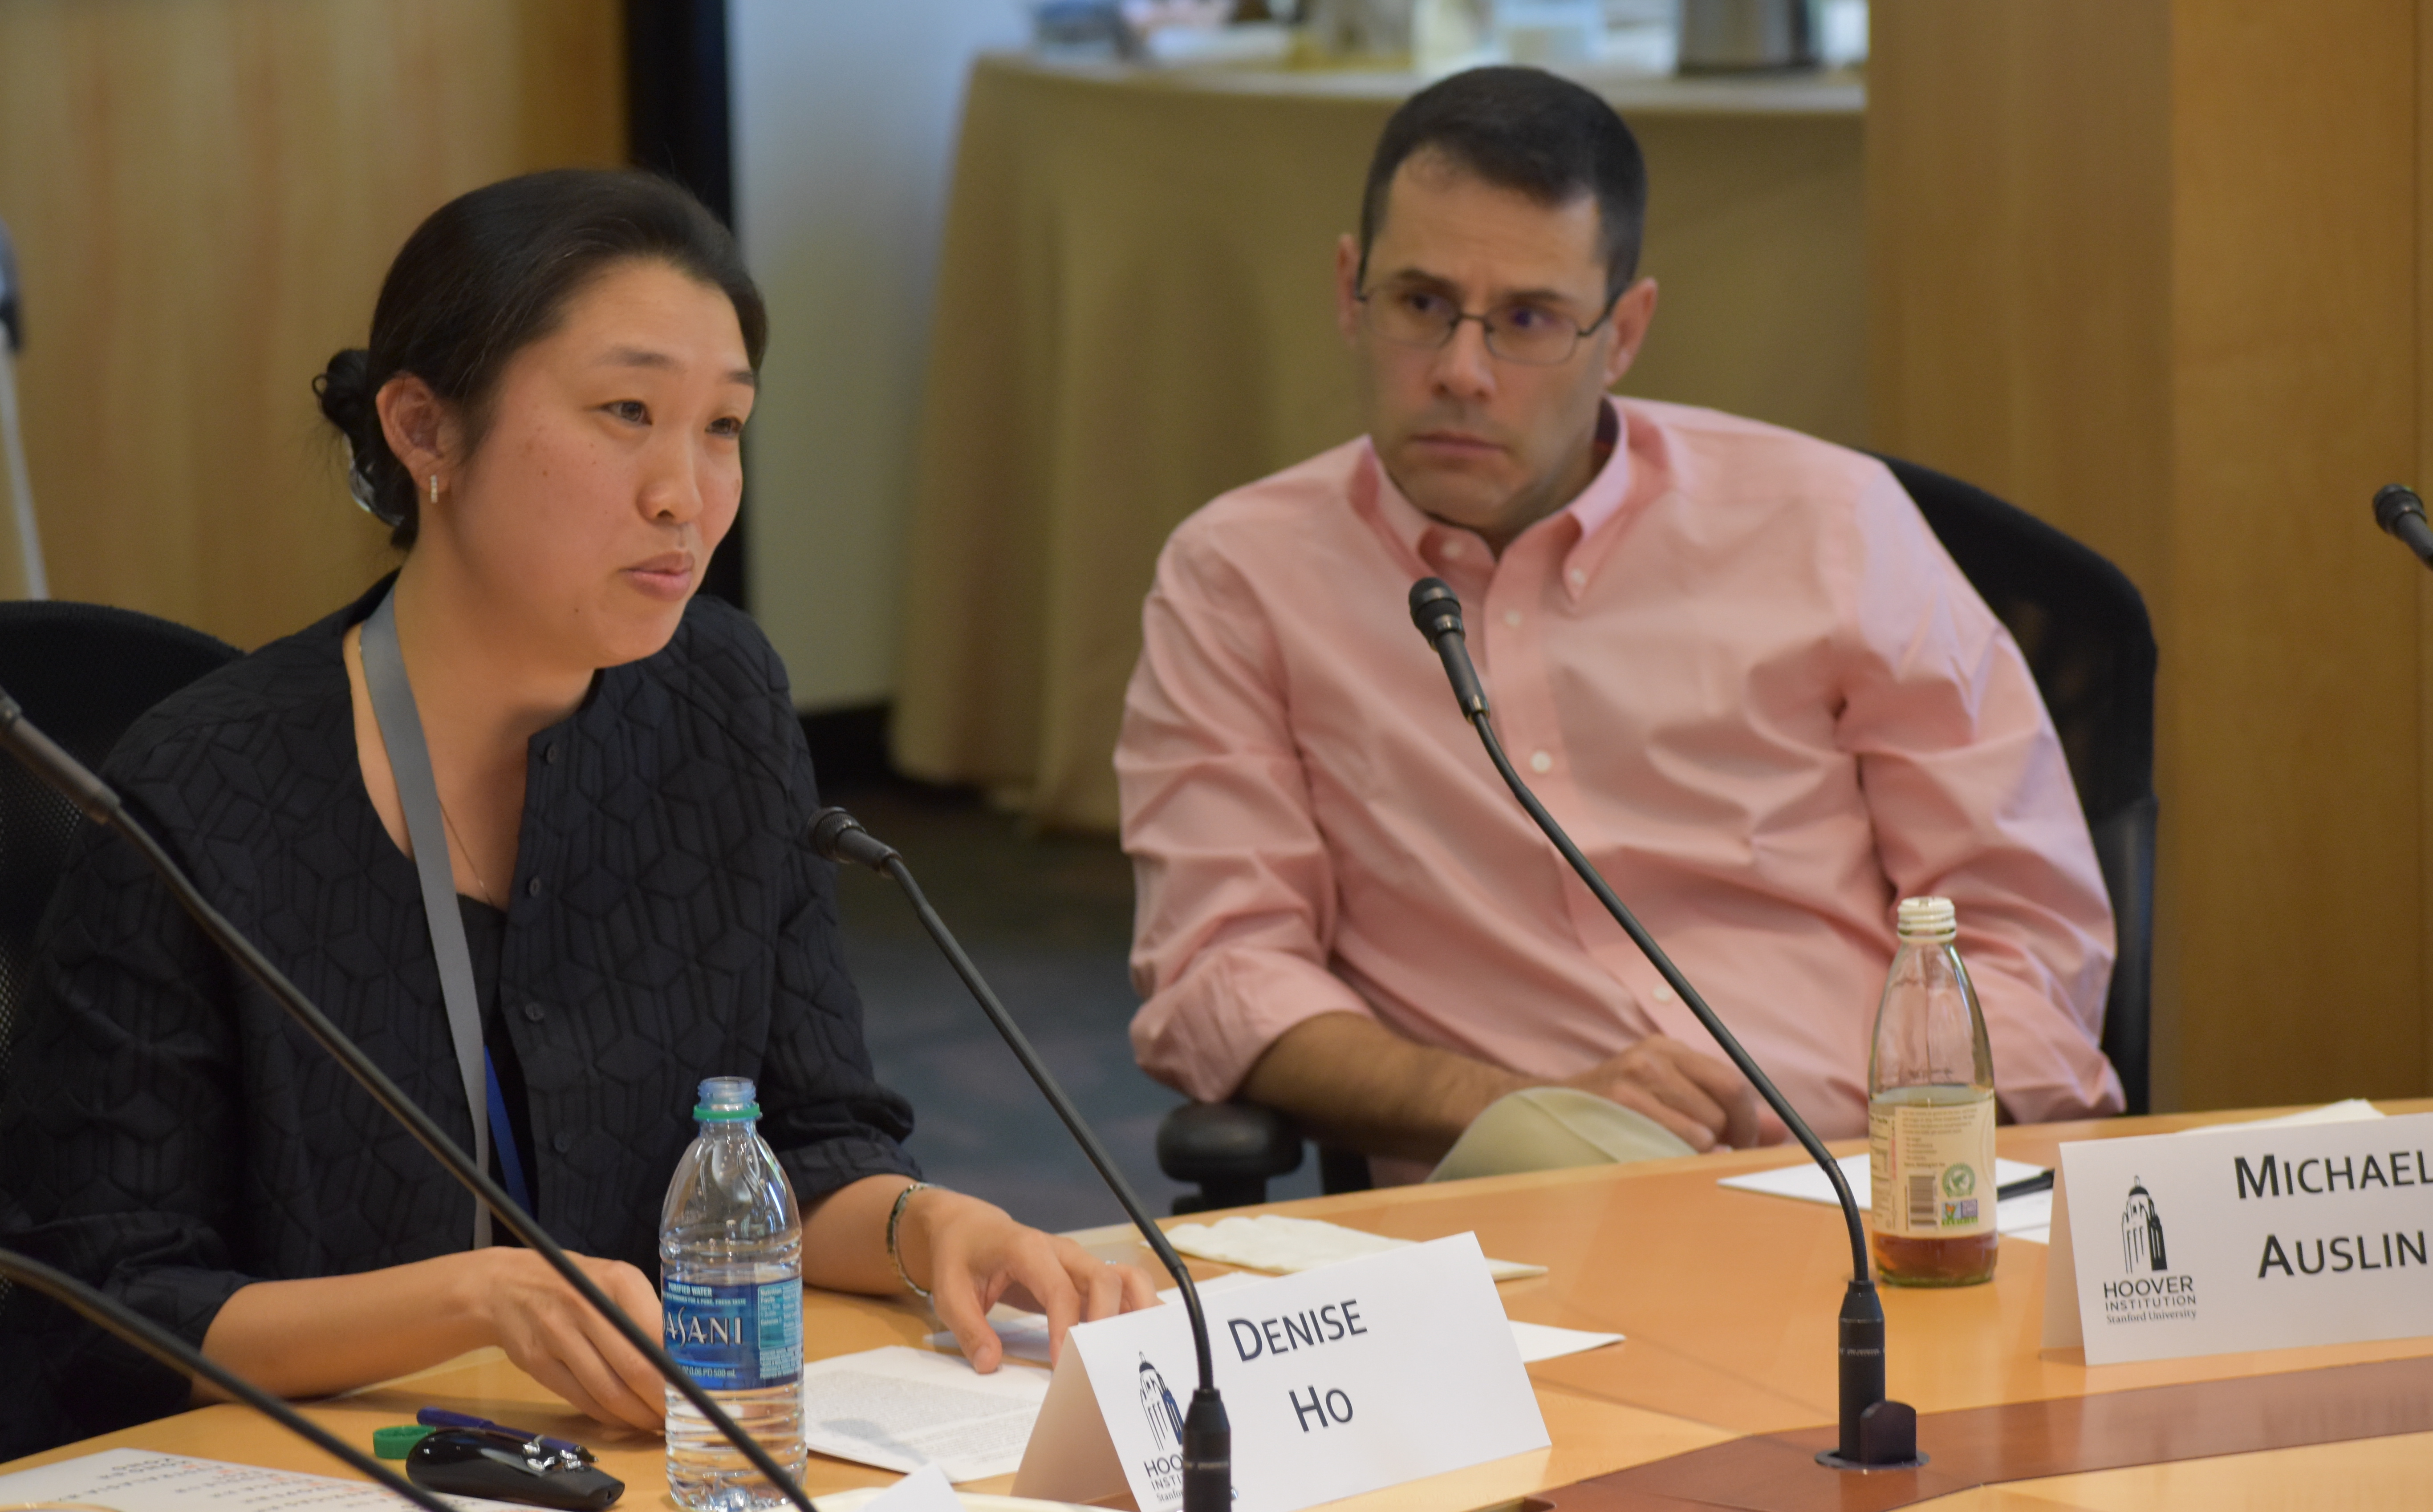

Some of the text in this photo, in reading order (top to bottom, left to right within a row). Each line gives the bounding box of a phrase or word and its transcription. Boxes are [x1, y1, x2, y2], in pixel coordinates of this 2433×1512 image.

[2234, 1149, 2433, 1199] MICHAEL
[2258, 1229, 2427, 1279] AUSLIN
[668, 1282, 712, 1297] PURIFIED WATER
[2104, 1275, 2193, 1298] HOOVER
[2105, 1295, 2196, 1311] INSTITUTION
[663, 1306, 743, 1348] ASANI
[1228, 1299, 1368, 1363] DENISE
[2107, 1308, 2196, 1324] Stanford University
[1288, 1385, 1353, 1433] HO
